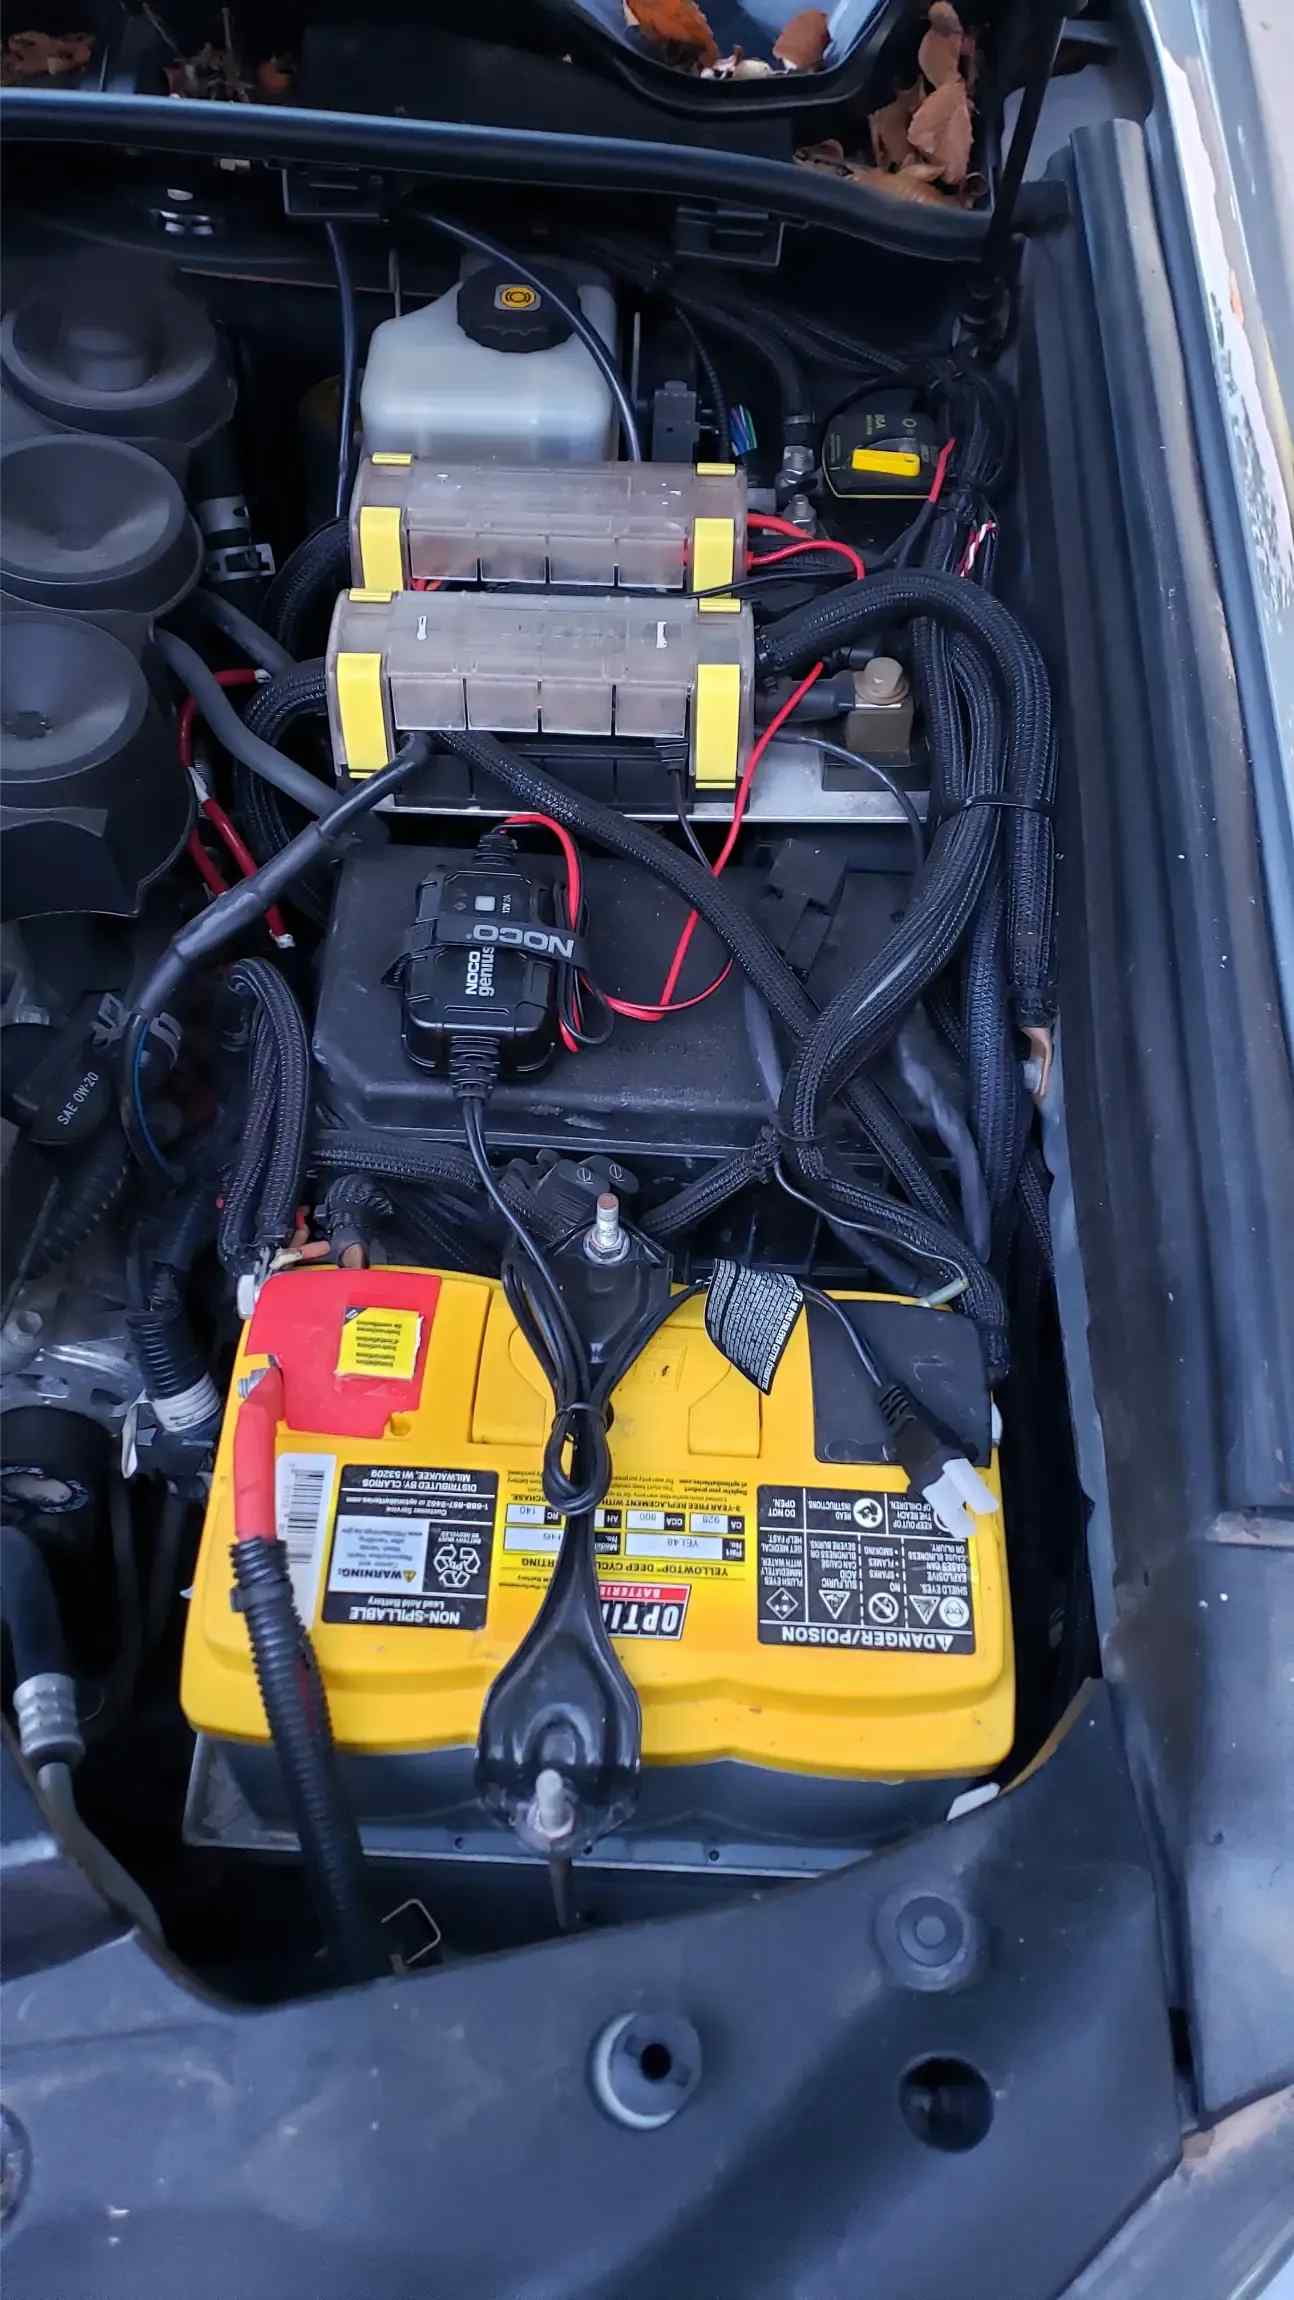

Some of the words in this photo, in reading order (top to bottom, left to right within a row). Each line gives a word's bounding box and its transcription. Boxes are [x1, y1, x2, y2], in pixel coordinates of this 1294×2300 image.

[473, 924, 575, 959] NOCO
[465, 951, 481, 995] NOCO
[478, 946, 495, 997] genius
[57, 1102, 79, 1125] SAE
[370, 1469, 401, 1479] 53209
[401, 1470, 414, 1480] WI
[415, 1470, 471, 1482] MILWAUKEE,
[362, 1478, 402, 1489] CLARIOS
[418, 1480, 477, 1493] DISTRIBUTED
[626, 1499, 687, 1510] REPLACEMENT
[687, 1503, 709, 1511] FREE
[772, 1498, 796, 1508] OPEN.
[889, 1500, 922, 1511] CHILDREN.
[922, 1503, 931, 1511] OF
[385, 1506, 412, 1515] Service
[413, 1507, 447, 1516] Customer
[546, 1511, 559, 1520] RC
[767, 1507, 784, 1517] NOT
[784, 1508, 796, 1518] DO
[896, 1510, 918, 1520] REACH
[919, 1511, 932, 1520] THE
[607, 1513, 619, 1523] AH
[835, 1511, 852, 1521] READ
[665, 1517, 683, 1526] CCA
[730, 1520, 742, 1529] CA
[892, 1519, 901, 1528] OF
[901, 1520, 915, 1529] OUT
[915, 1521, 932, 1530] KEEP
[605, 1535, 618, 1543] No.
[785, 1535, 802, 1544] HELP
[594, 1543, 617, 1552] Model
[760, 1542, 789, 1554] MEDICAL
[789, 1544, 802, 1554] GET
[832, 1541, 856, 1551] SEVERE
[863, 1546, 893, 1556] SMOKING
[955, 1544, 965, 1554] OR
[725, 1548, 742, 1558] Part
[820, 1550, 856, 1560] BLINDNESS
[907, 1550, 943, 1561] BLINDNESS
[521, 1557, 554, 1568] RTING
[596, 1560, 623, 1573] CYCL
[785, 1558, 802, 1568] WITH
[821, 1559, 842, 1569] CAUSE
[842, 1560, 857, 1569] CAN
[868, 1557, 894, 1568] FLAMES
[926, 1561, 942, 1571] CAN
[337, 1567, 402, 1580] WARNING:
[625, 1562, 654, 1575] DEEP
[760, 1566, 803, 1577] IMMEDIATELY
[839, 1569, 857, 1579] ACID
[869, 1569, 894, 1579] SPARKS
[926, 1571, 967, 1583] EXPLOSIVE
[781, 1576, 803, 1587] FLUSH
[821, 1577, 857, 1589] SULFURIC
[889, 1582, 900, 1592] NO
[942, 1584, 968, 1596] SHIELD
[599, 1586, 661, 1600] BATTERIE
[367, 1595, 400, 1606] Battery
[401, 1598, 421, 1608] Acid
[422, 1599, 444, 1610] Lead
[348, 1606, 460, 1625] NON-SPILLABLE
[601, 1603, 680, 1633] OPTI
[782, 1626, 936, 1649] DANGER/POISON
